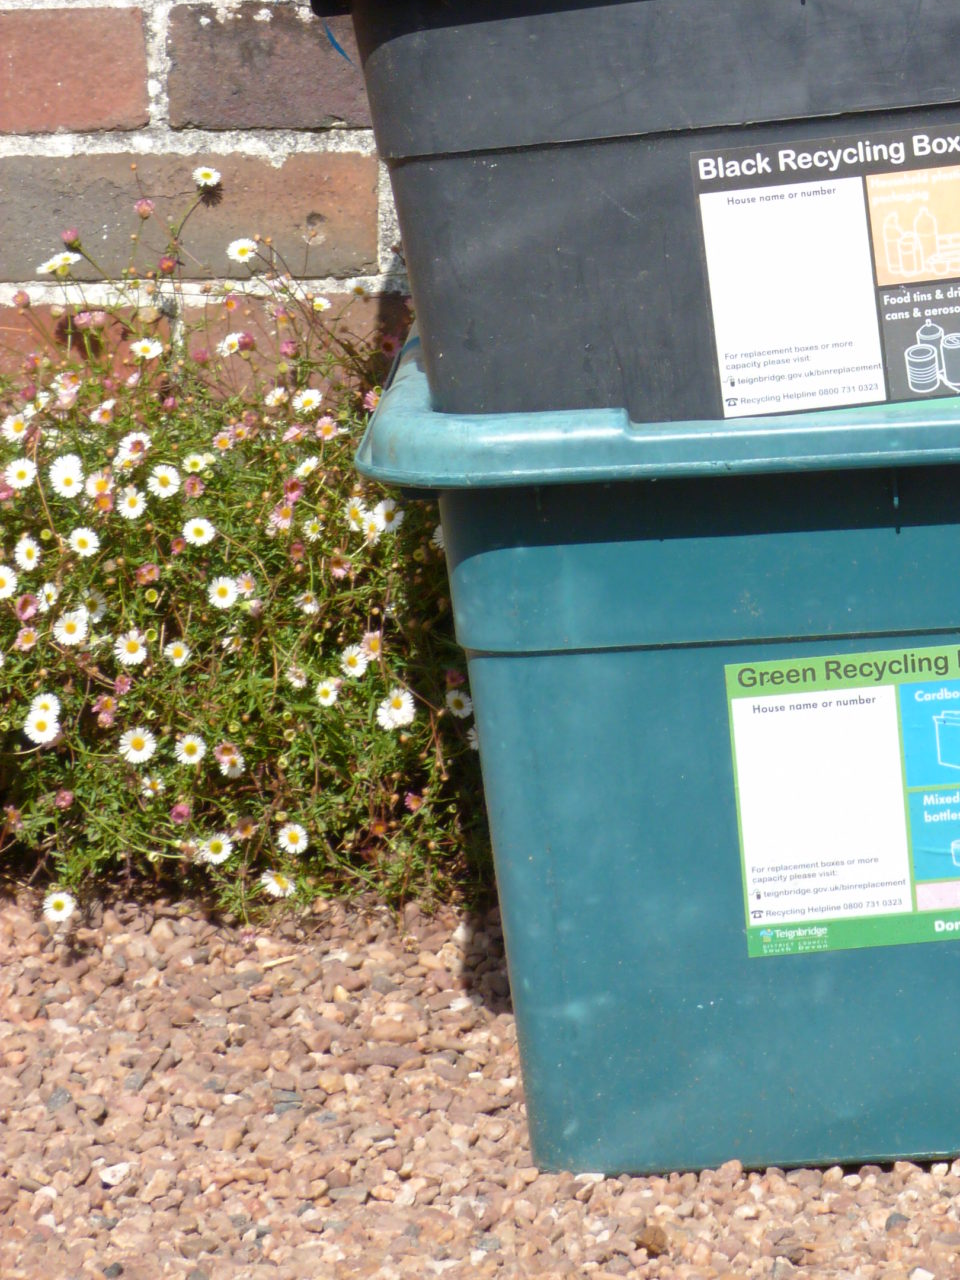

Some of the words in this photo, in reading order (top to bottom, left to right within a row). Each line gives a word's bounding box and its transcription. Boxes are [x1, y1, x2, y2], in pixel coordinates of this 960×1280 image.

[698, 153, 772, 180] Black
[778, 141, 905, 172] Recycling
[727, 195, 757, 206] House
[759, 192, 785, 202] name
[788, 191, 798, 199] or
[801, 187, 836, 197] number
[883, 292, 910, 305] Food
[913, 292, 932, 302] tins
[935, 289, 944, 299] &
[885, 311, 910, 320] cans
[913, 308, 921, 318] &
[741, 346, 792, 358] replacement
[794, 344, 818, 353] boxes
[831, 340, 853, 349] more
[726, 360, 761, 370] capacity
[763, 357, 790, 367] please
[740, 391, 781, 405] Recycling
[782, 390, 816, 401] Helpline
[818, 387, 839, 396] 0800
[842, 386, 856, 394] 731
[858, 383, 879, 392] 0323
[738, 666, 817, 688] Green
[825, 653, 949, 682] Recycling
[752, 704, 786, 714] House
[789, 700, 818, 711] name
[822, 699, 833, 708] or
[836, 695, 876, 707] number
[923, 791, 960, 806] Mixed
[767, 862, 819, 873] replacement
[821, 860, 845, 868] boxes
[753, 874, 787, 884] capacity
[790, 872, 817, 881] please
[766, 905, 806, 917] Recycling
[808, 904, 841, 914] Helpline
[774, 926, 827, 939] Teignbridge
